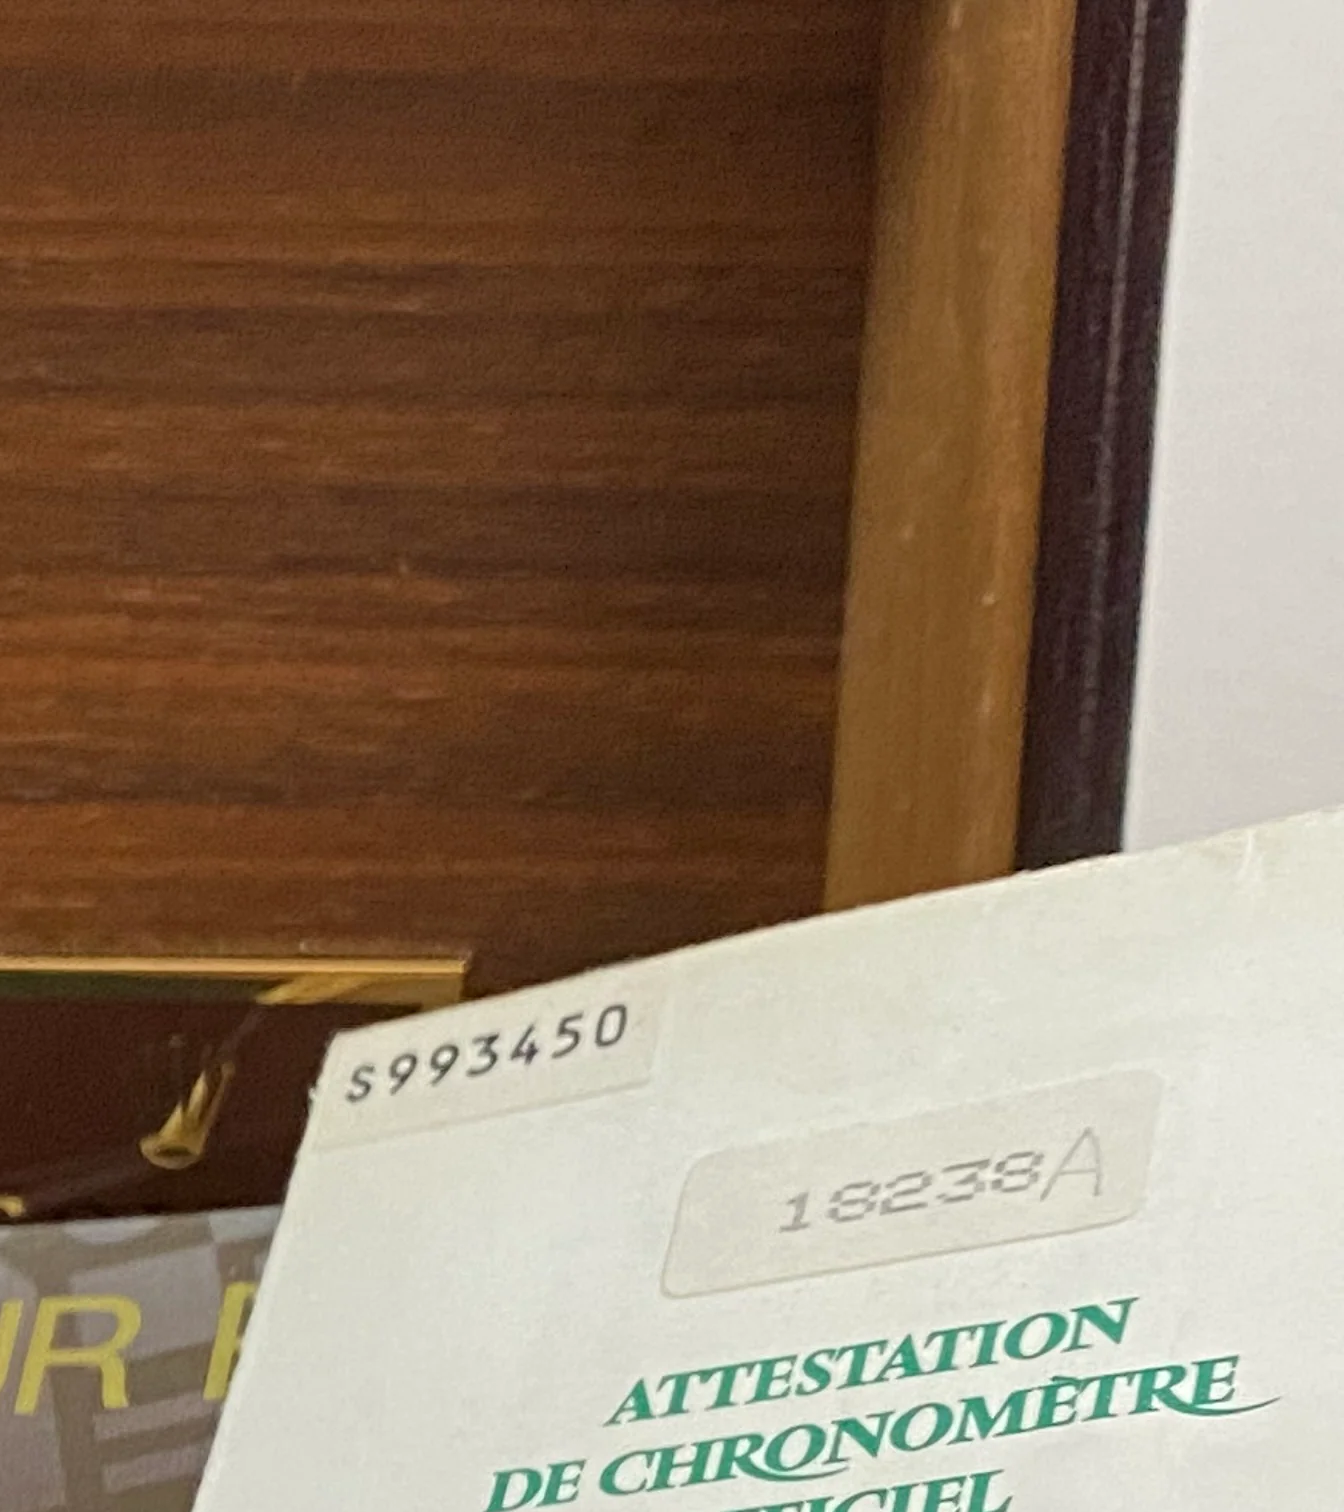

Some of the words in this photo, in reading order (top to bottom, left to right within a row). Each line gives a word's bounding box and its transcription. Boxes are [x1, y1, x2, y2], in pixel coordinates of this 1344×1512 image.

[345, 1003, 629, 1102] S993450
[777, 1127, 1105, 1234] 18238A
[605, 1297, 1140, 1427] ATTESTATION
[598, 1355, 1281, 1497] CHRONOMÈTRE
